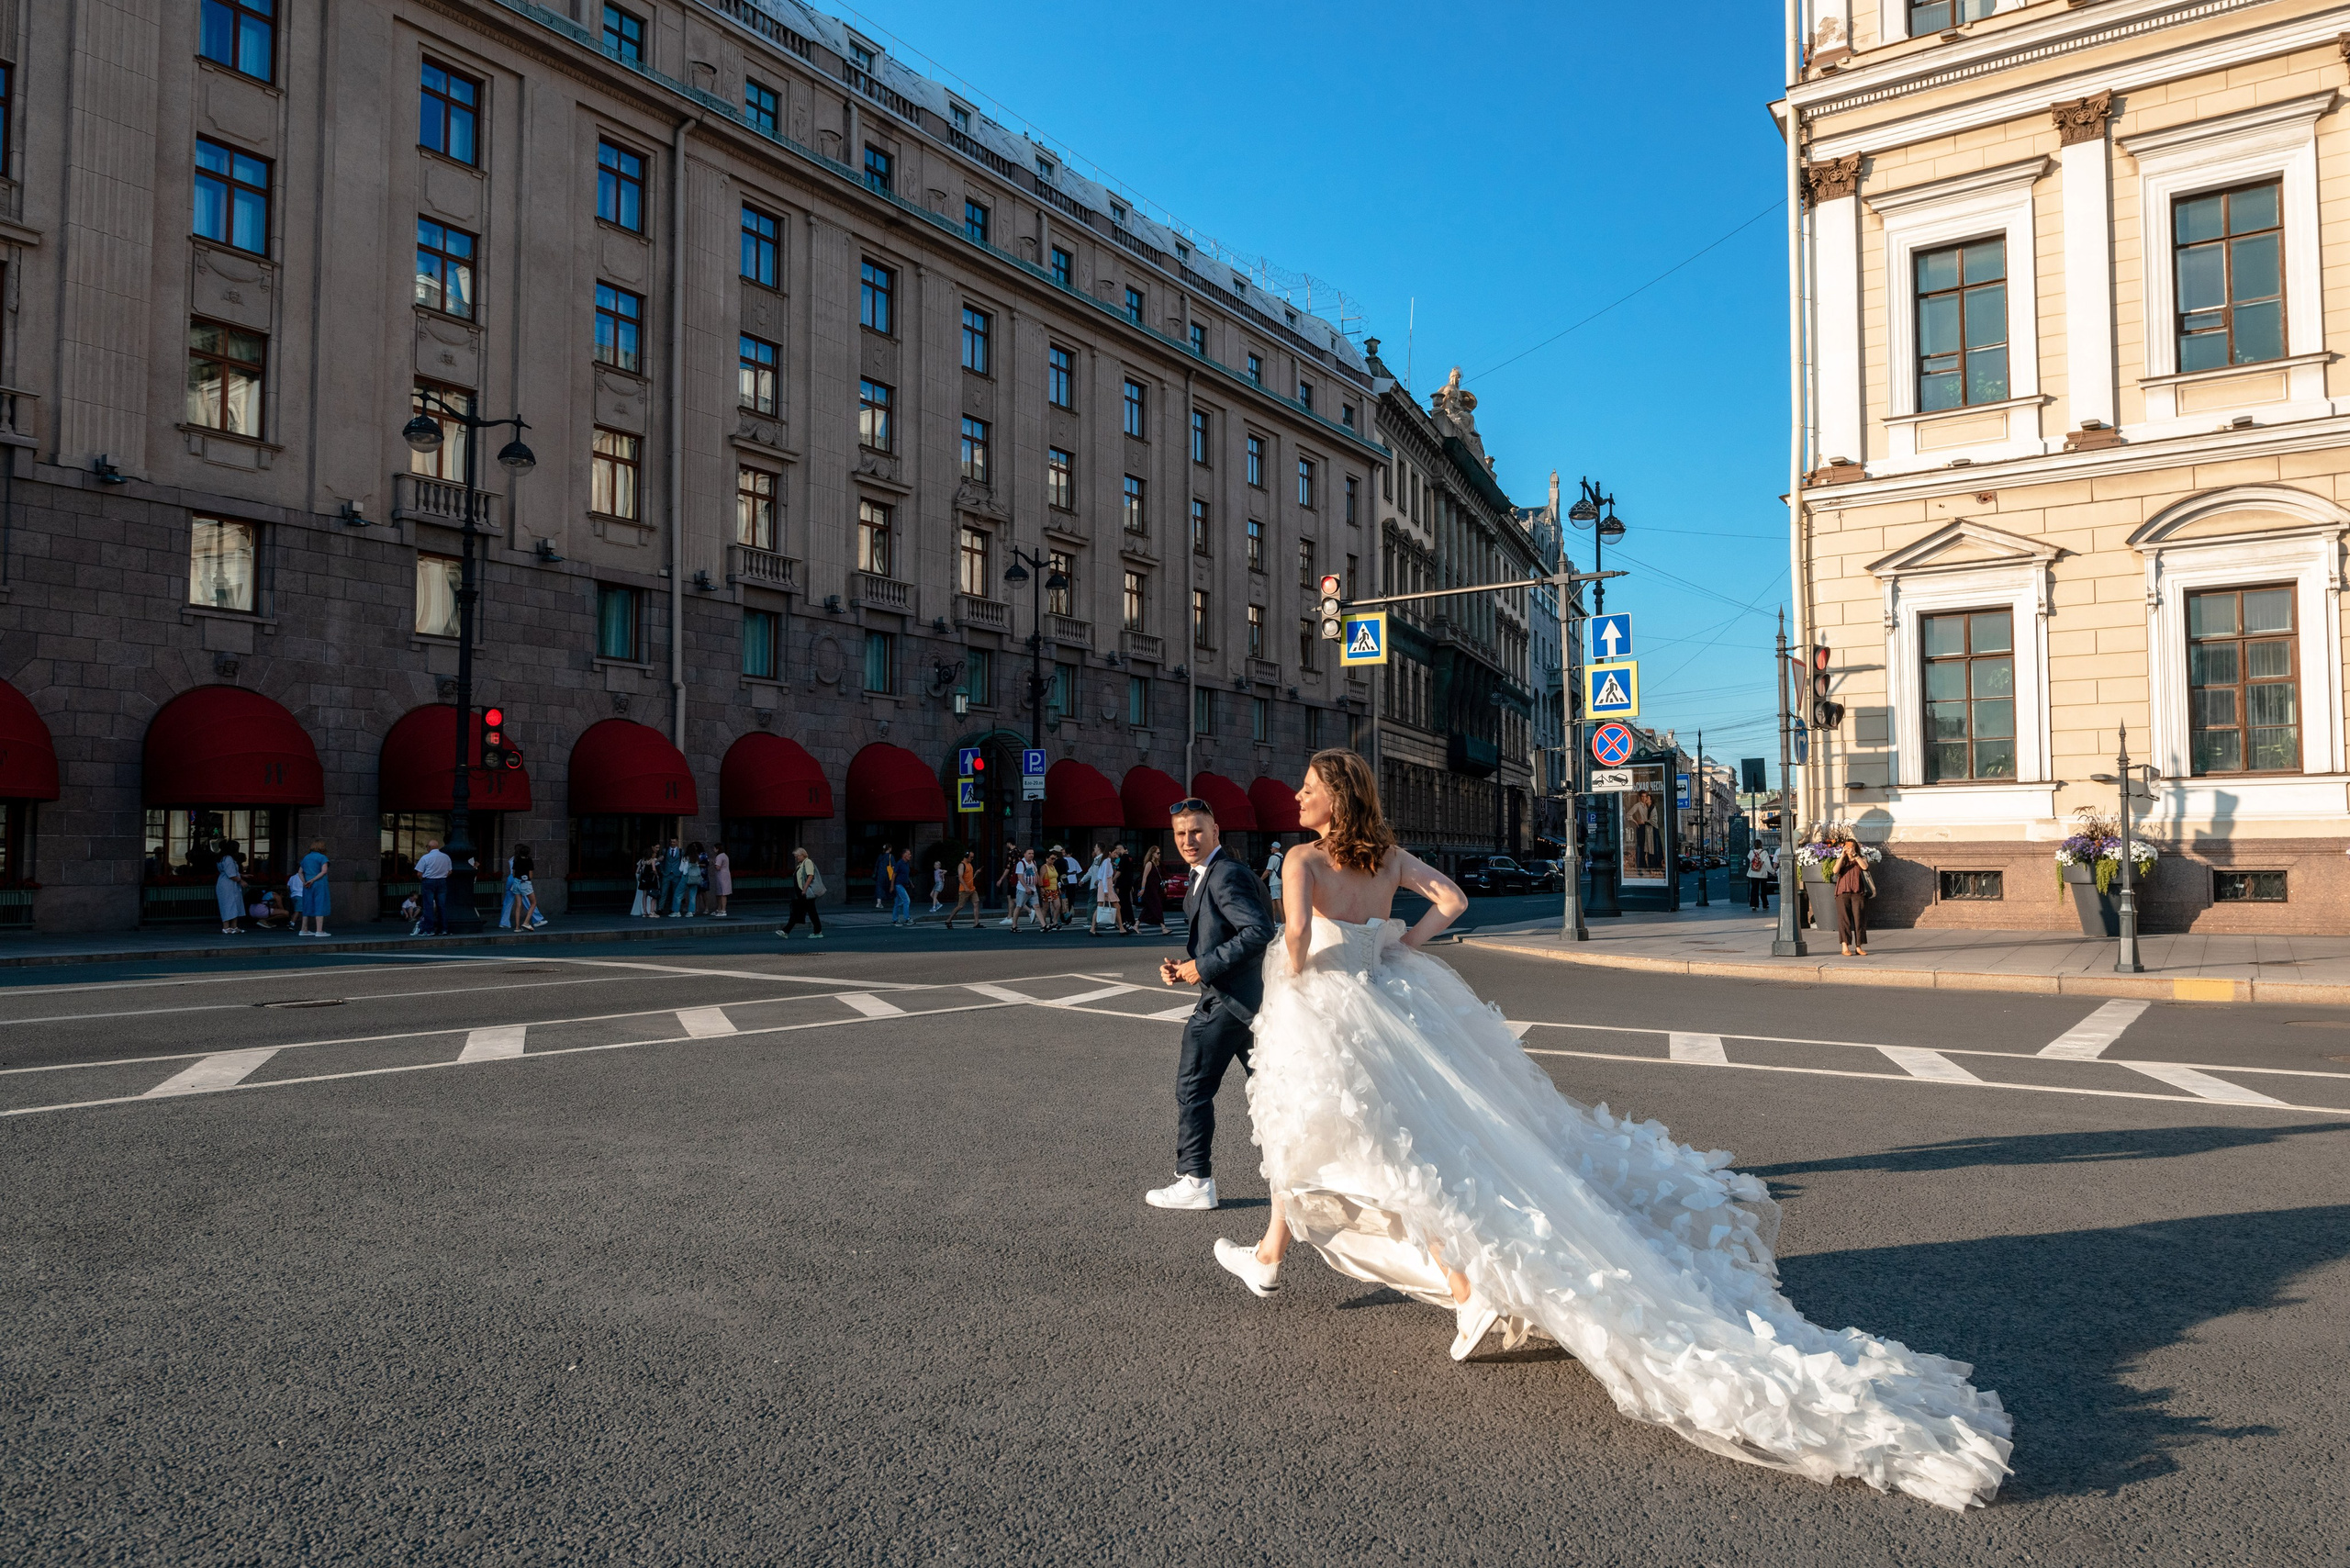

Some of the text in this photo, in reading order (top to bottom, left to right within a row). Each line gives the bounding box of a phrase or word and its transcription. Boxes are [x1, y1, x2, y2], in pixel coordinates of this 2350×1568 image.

[1029, 752, 1042, 772] P
[1631, 780, 1663, 791] ЬСКАЯ ЧЕСТЬ
